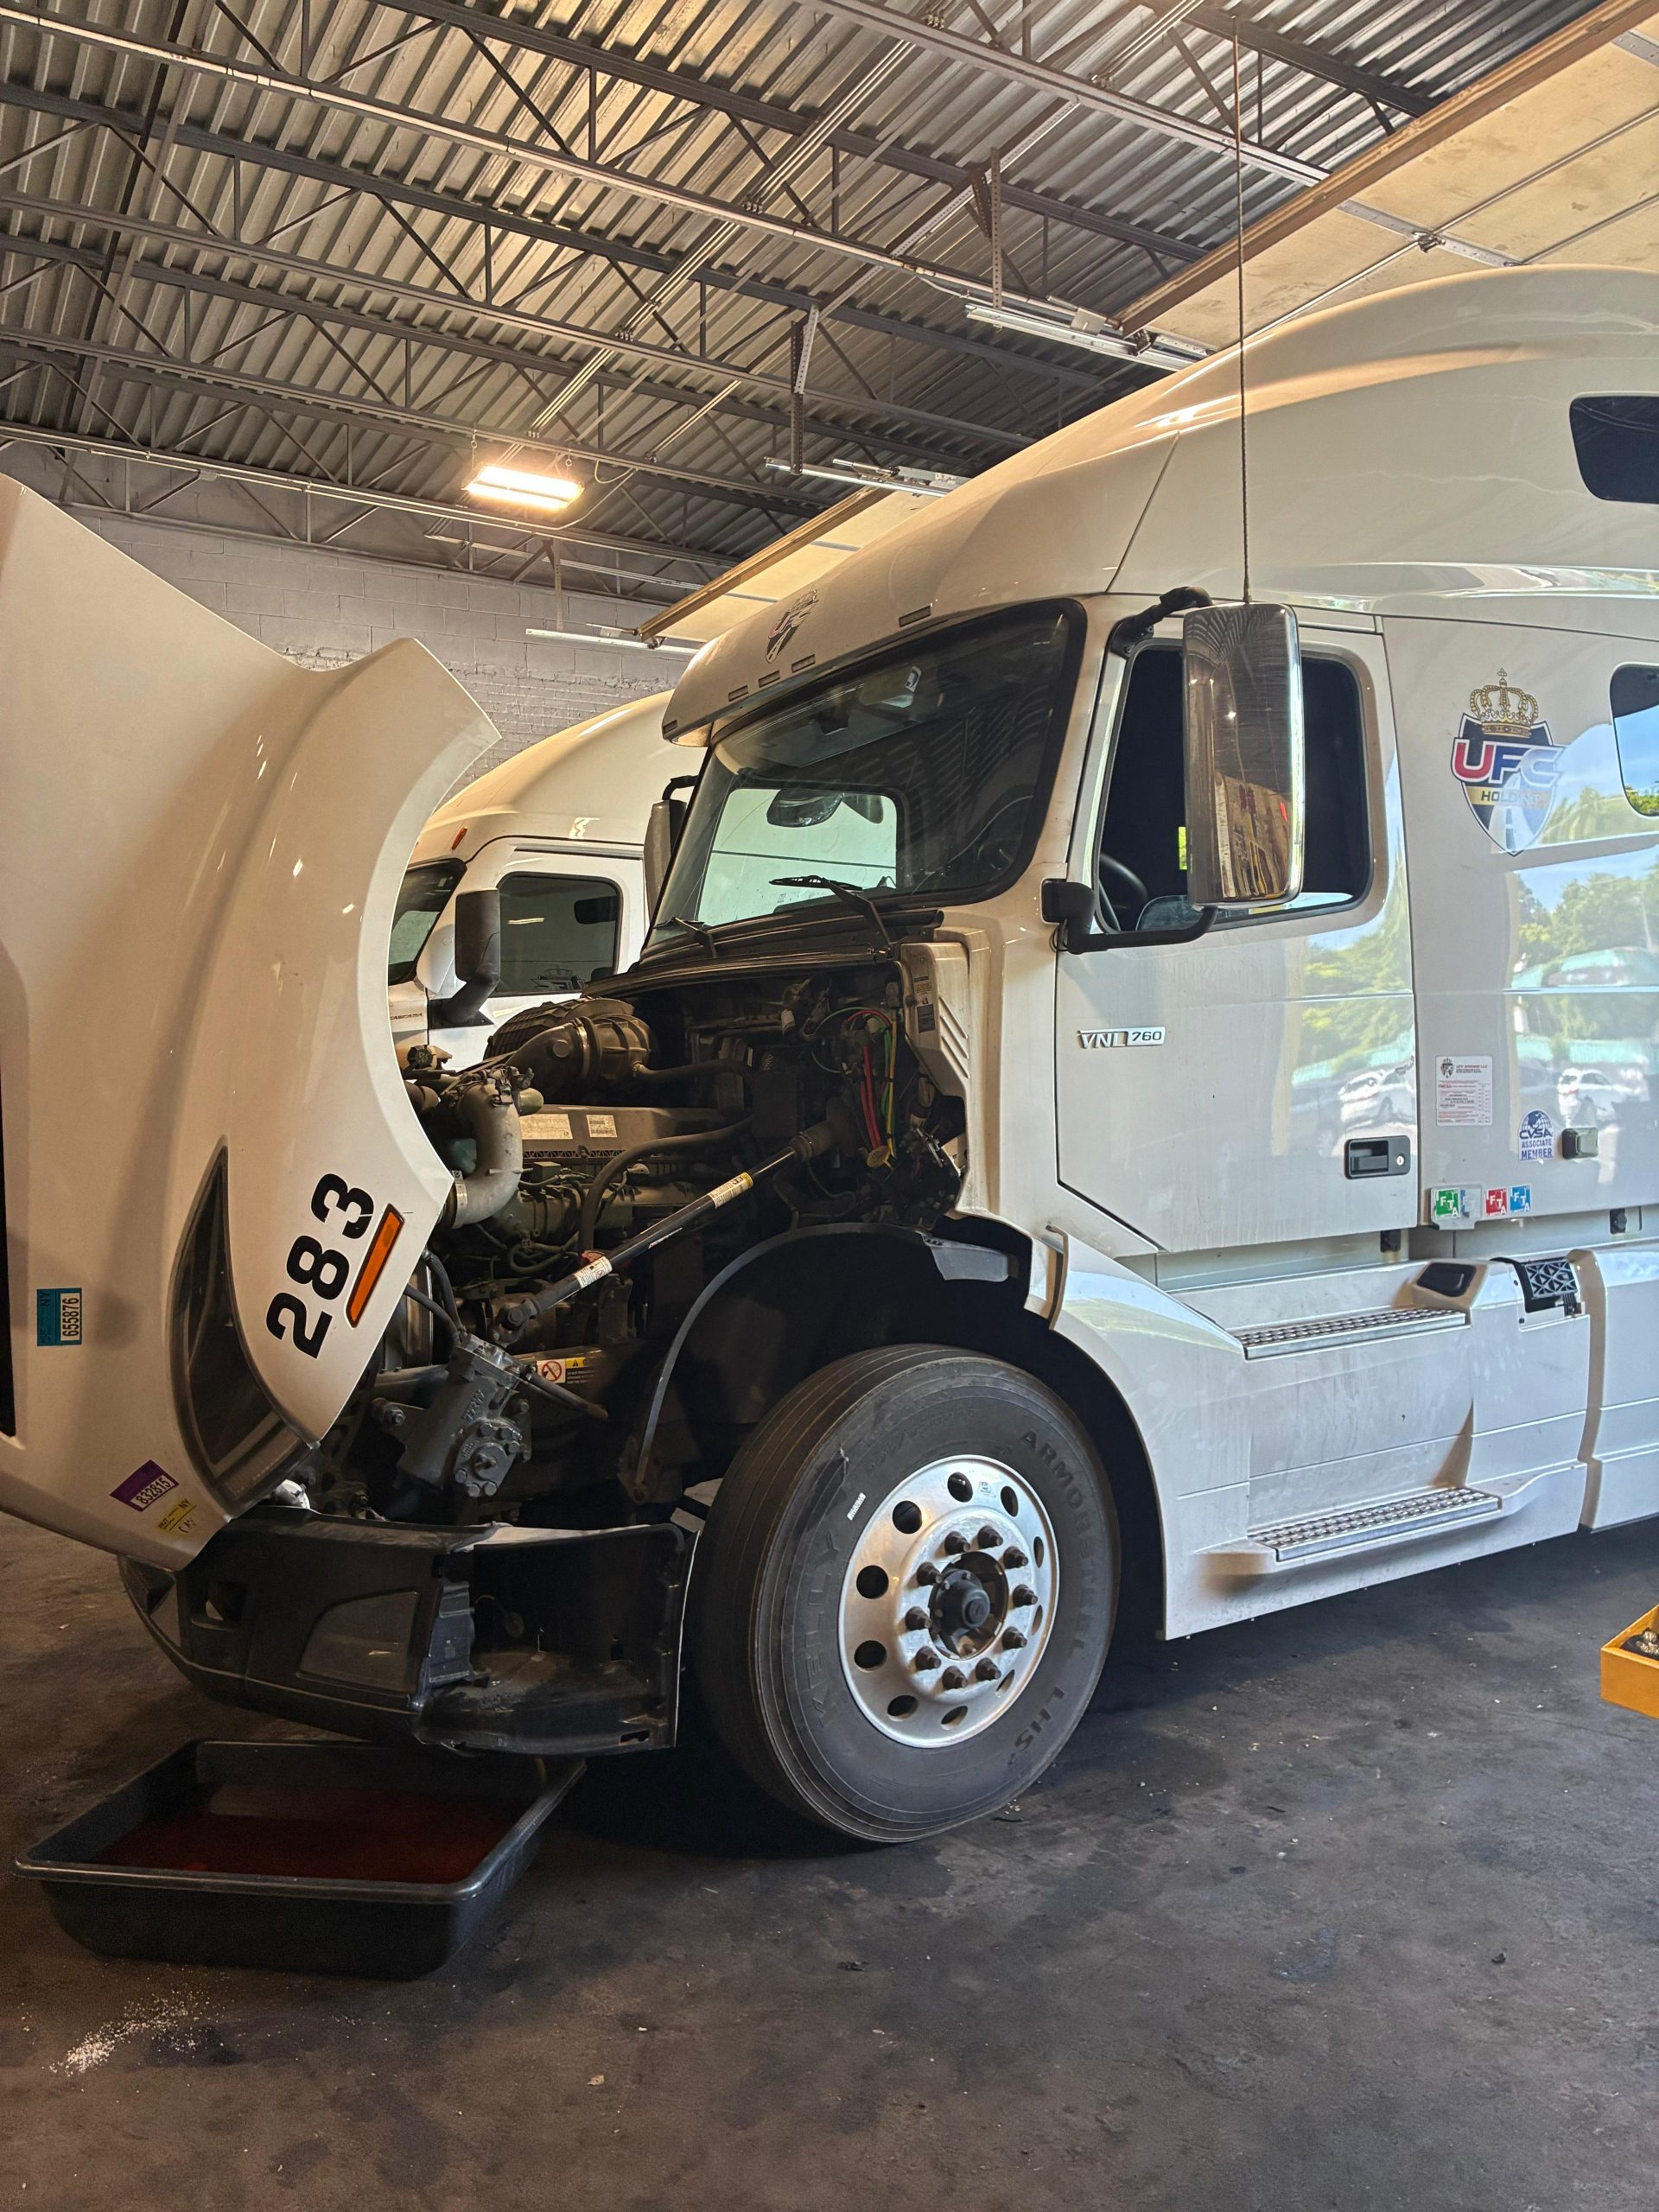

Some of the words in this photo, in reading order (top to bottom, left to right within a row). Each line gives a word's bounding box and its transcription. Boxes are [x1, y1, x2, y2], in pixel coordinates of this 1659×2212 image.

[1452, 738, 1566, 787] UFC
[1077, 1032, 1126, 1049] VNL
[1132, 1031, 1162, 1042] 760
[1520, 1128, 1553, 1139] CVSA
[1522, 1138, 1553, 1148] ASSOCIATE
[1521, 1147, 1553, 1160] MEMBER
[265, 1173, 375, 1359] 283
[61, 1298, 79, 1337] 655876
[136, 1478, 171, 1504] 832815
